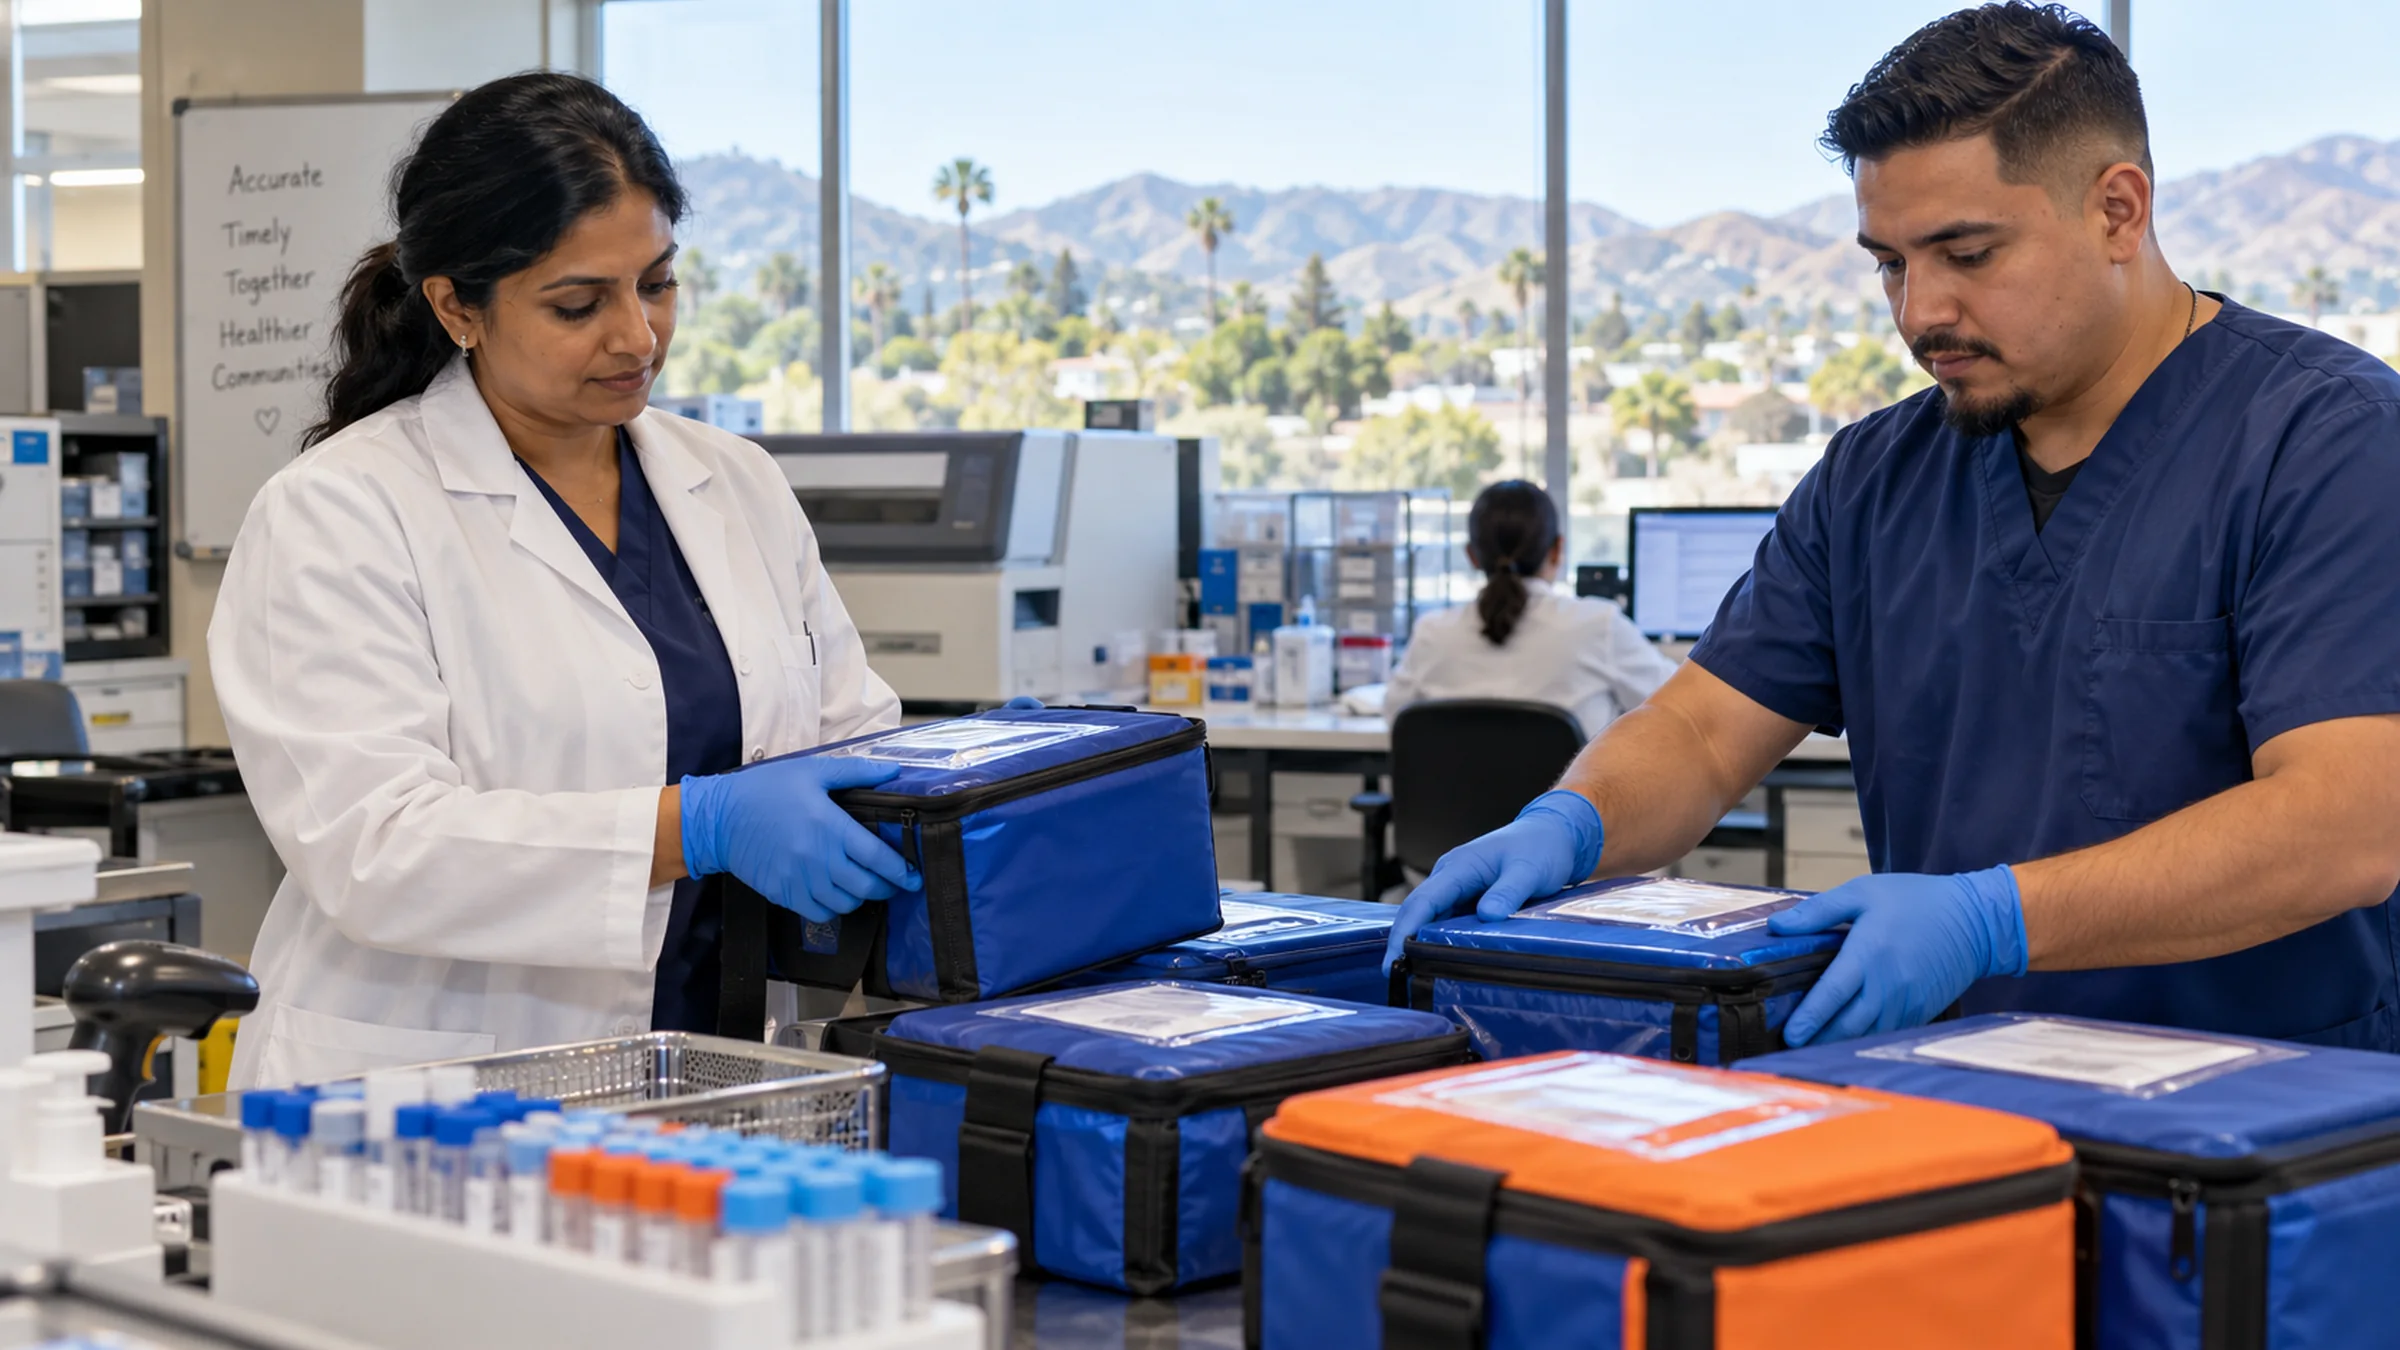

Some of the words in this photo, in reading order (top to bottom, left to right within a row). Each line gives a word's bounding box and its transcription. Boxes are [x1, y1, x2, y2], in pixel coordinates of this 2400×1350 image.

[228, 162, 324, 194] Accurate
[222, 217, 292, 255] Timely
[223, 265, 315, 306] Together
[220, 318, 312, 348] Healthier
[212, 359, 331, 392] Communities
